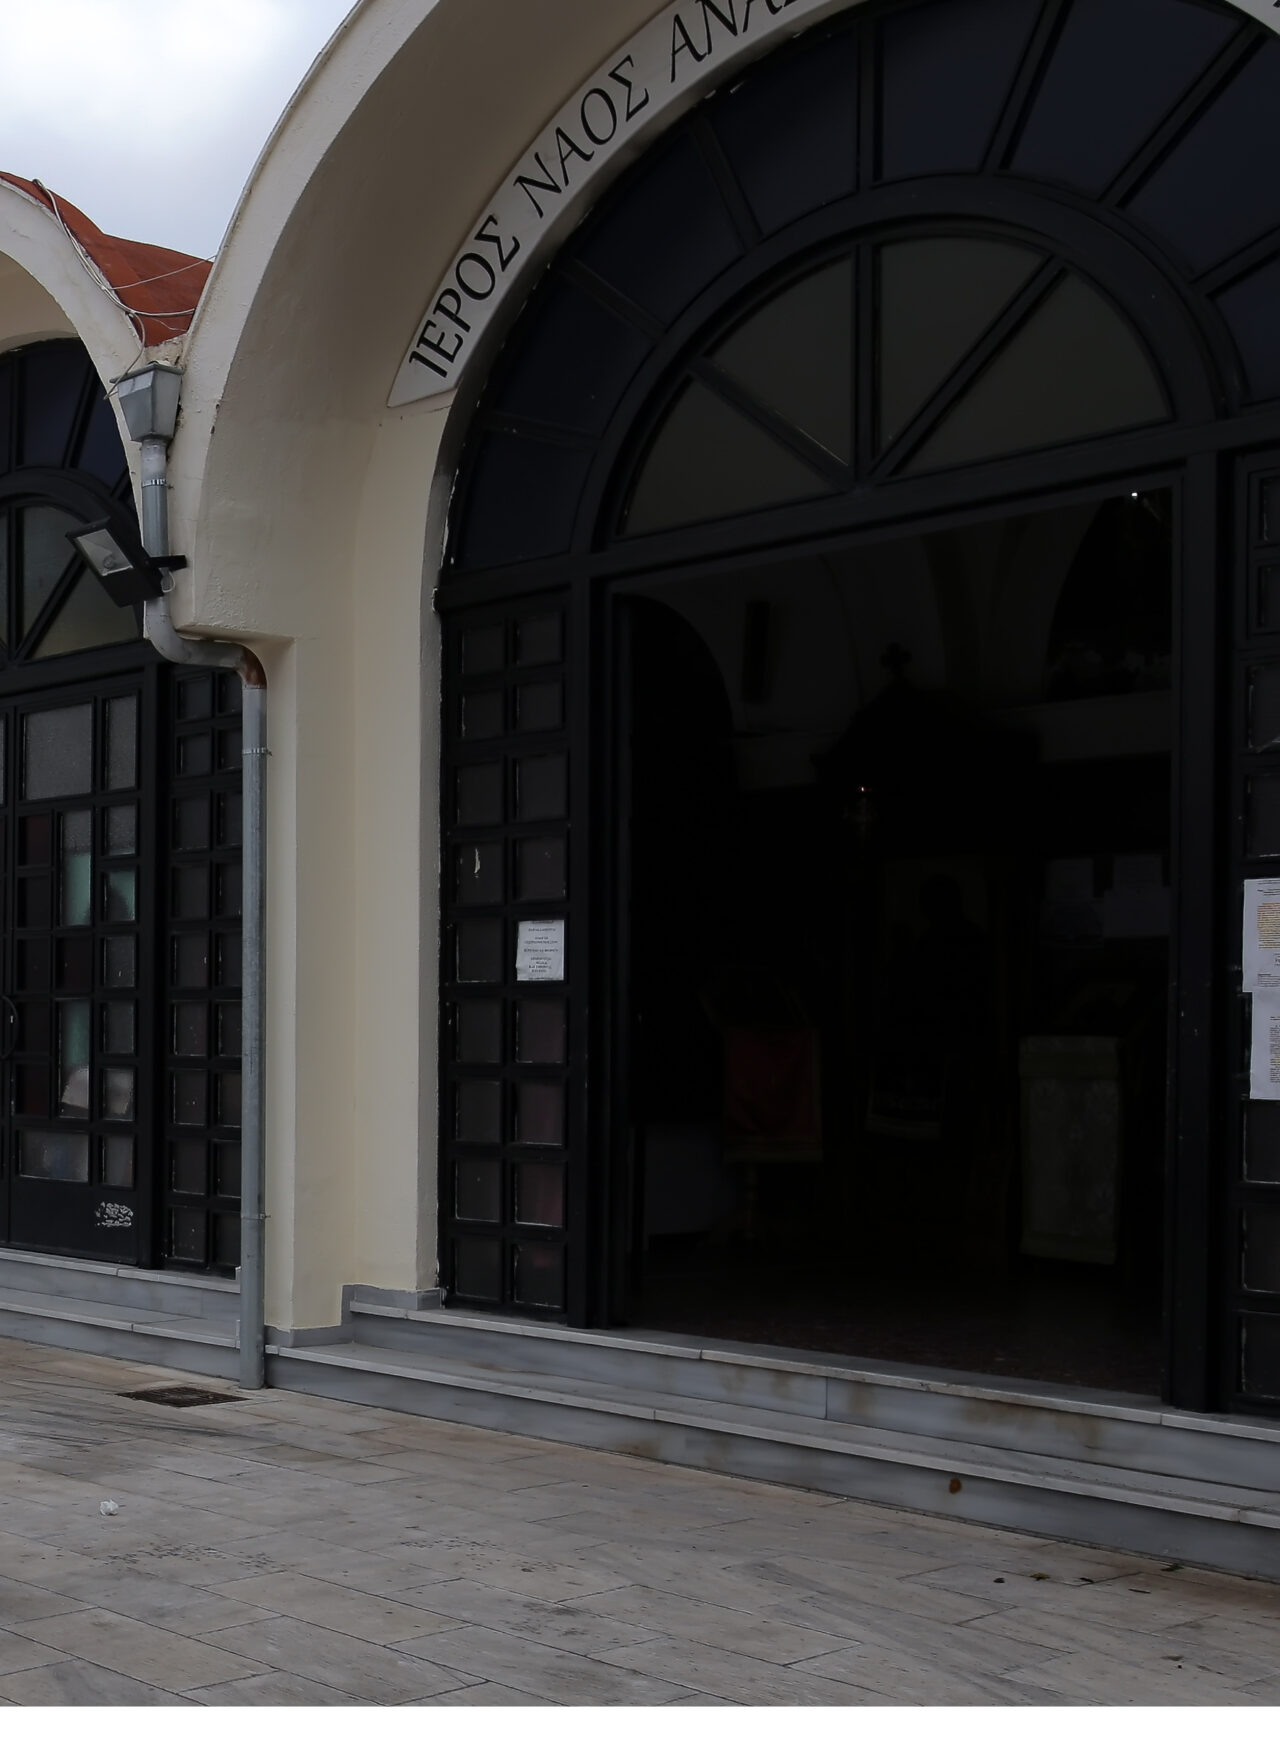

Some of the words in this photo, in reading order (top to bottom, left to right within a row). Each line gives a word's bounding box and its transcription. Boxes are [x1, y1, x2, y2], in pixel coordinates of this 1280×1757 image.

[409, 215, 521, 378] ΙΕΡΟΣ
[513, 55, 650, 218] ΝΑΟΣ
[670, 0, 799, 83] ΑΝ
